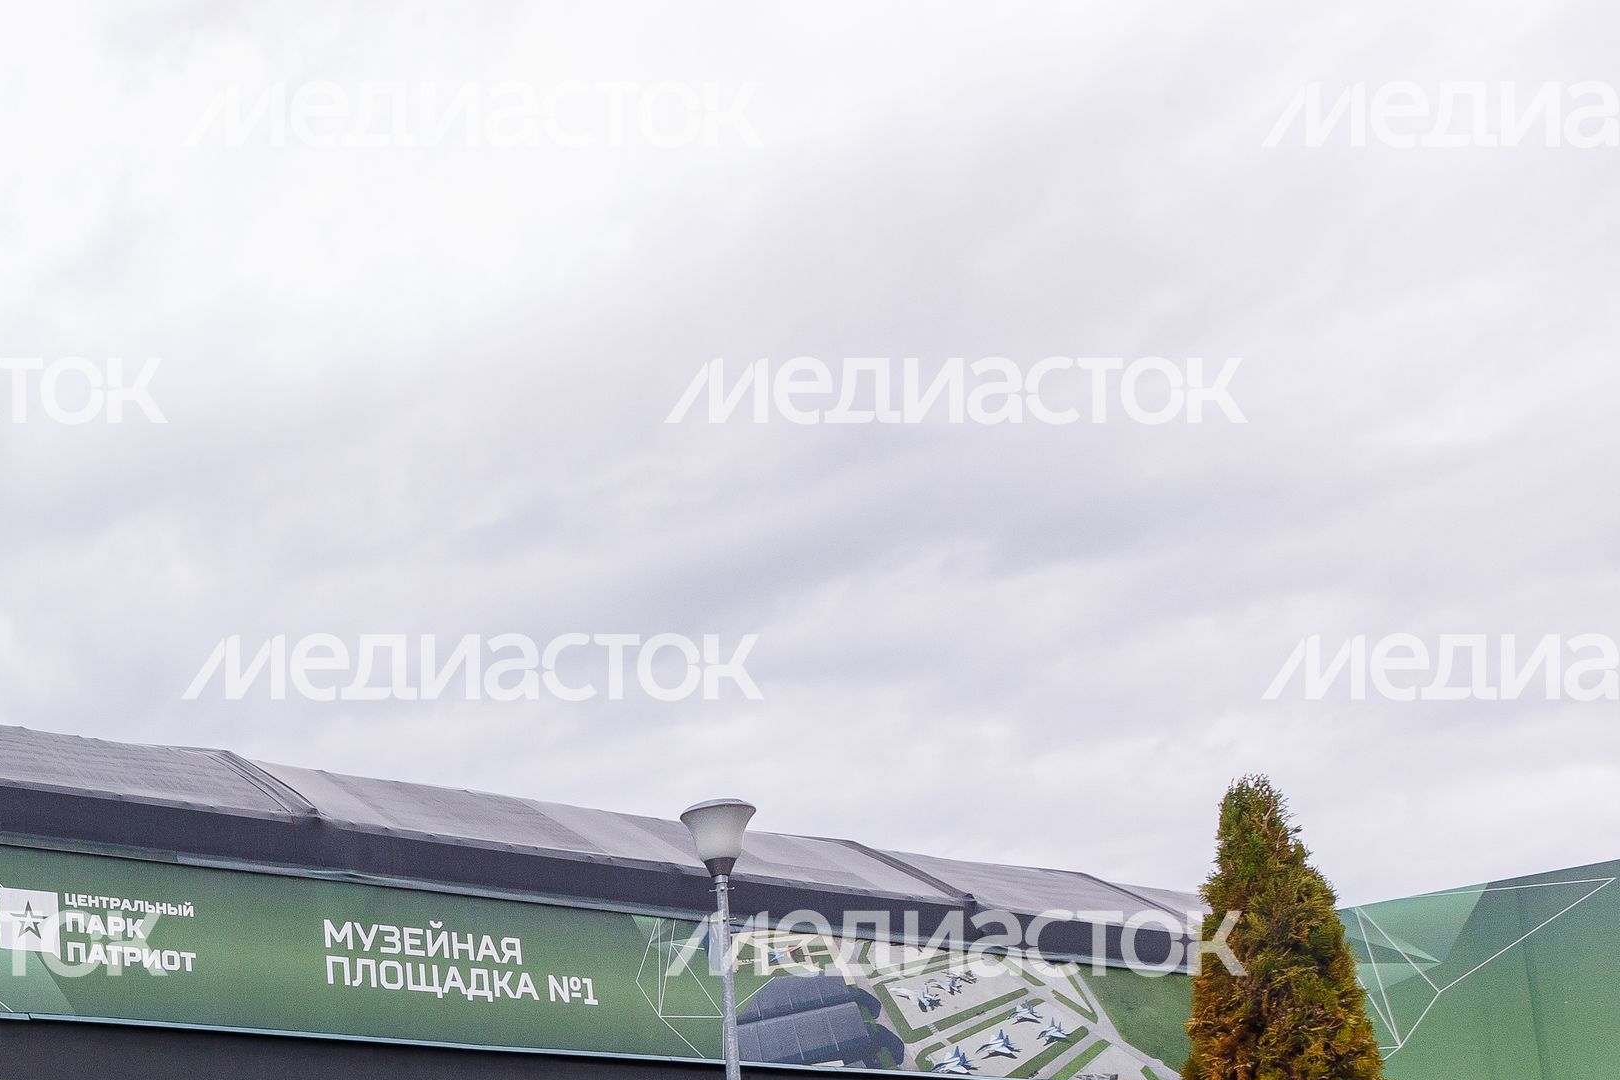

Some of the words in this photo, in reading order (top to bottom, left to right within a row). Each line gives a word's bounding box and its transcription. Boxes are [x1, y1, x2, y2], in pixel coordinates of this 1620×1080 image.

[65, 893, 194, 917] ЦЕНТРАЛЬНЫЙ
[66, 912, 145, 939] ПАРК
[67, 941, 196, 972] ПАТРИОТ
[324, 919, 522, 965] МУЗЕЙНАЯ
[326, 955, 540, 1002] ПЛОЩАДКА
[548, 974, 598, 1005] №1
